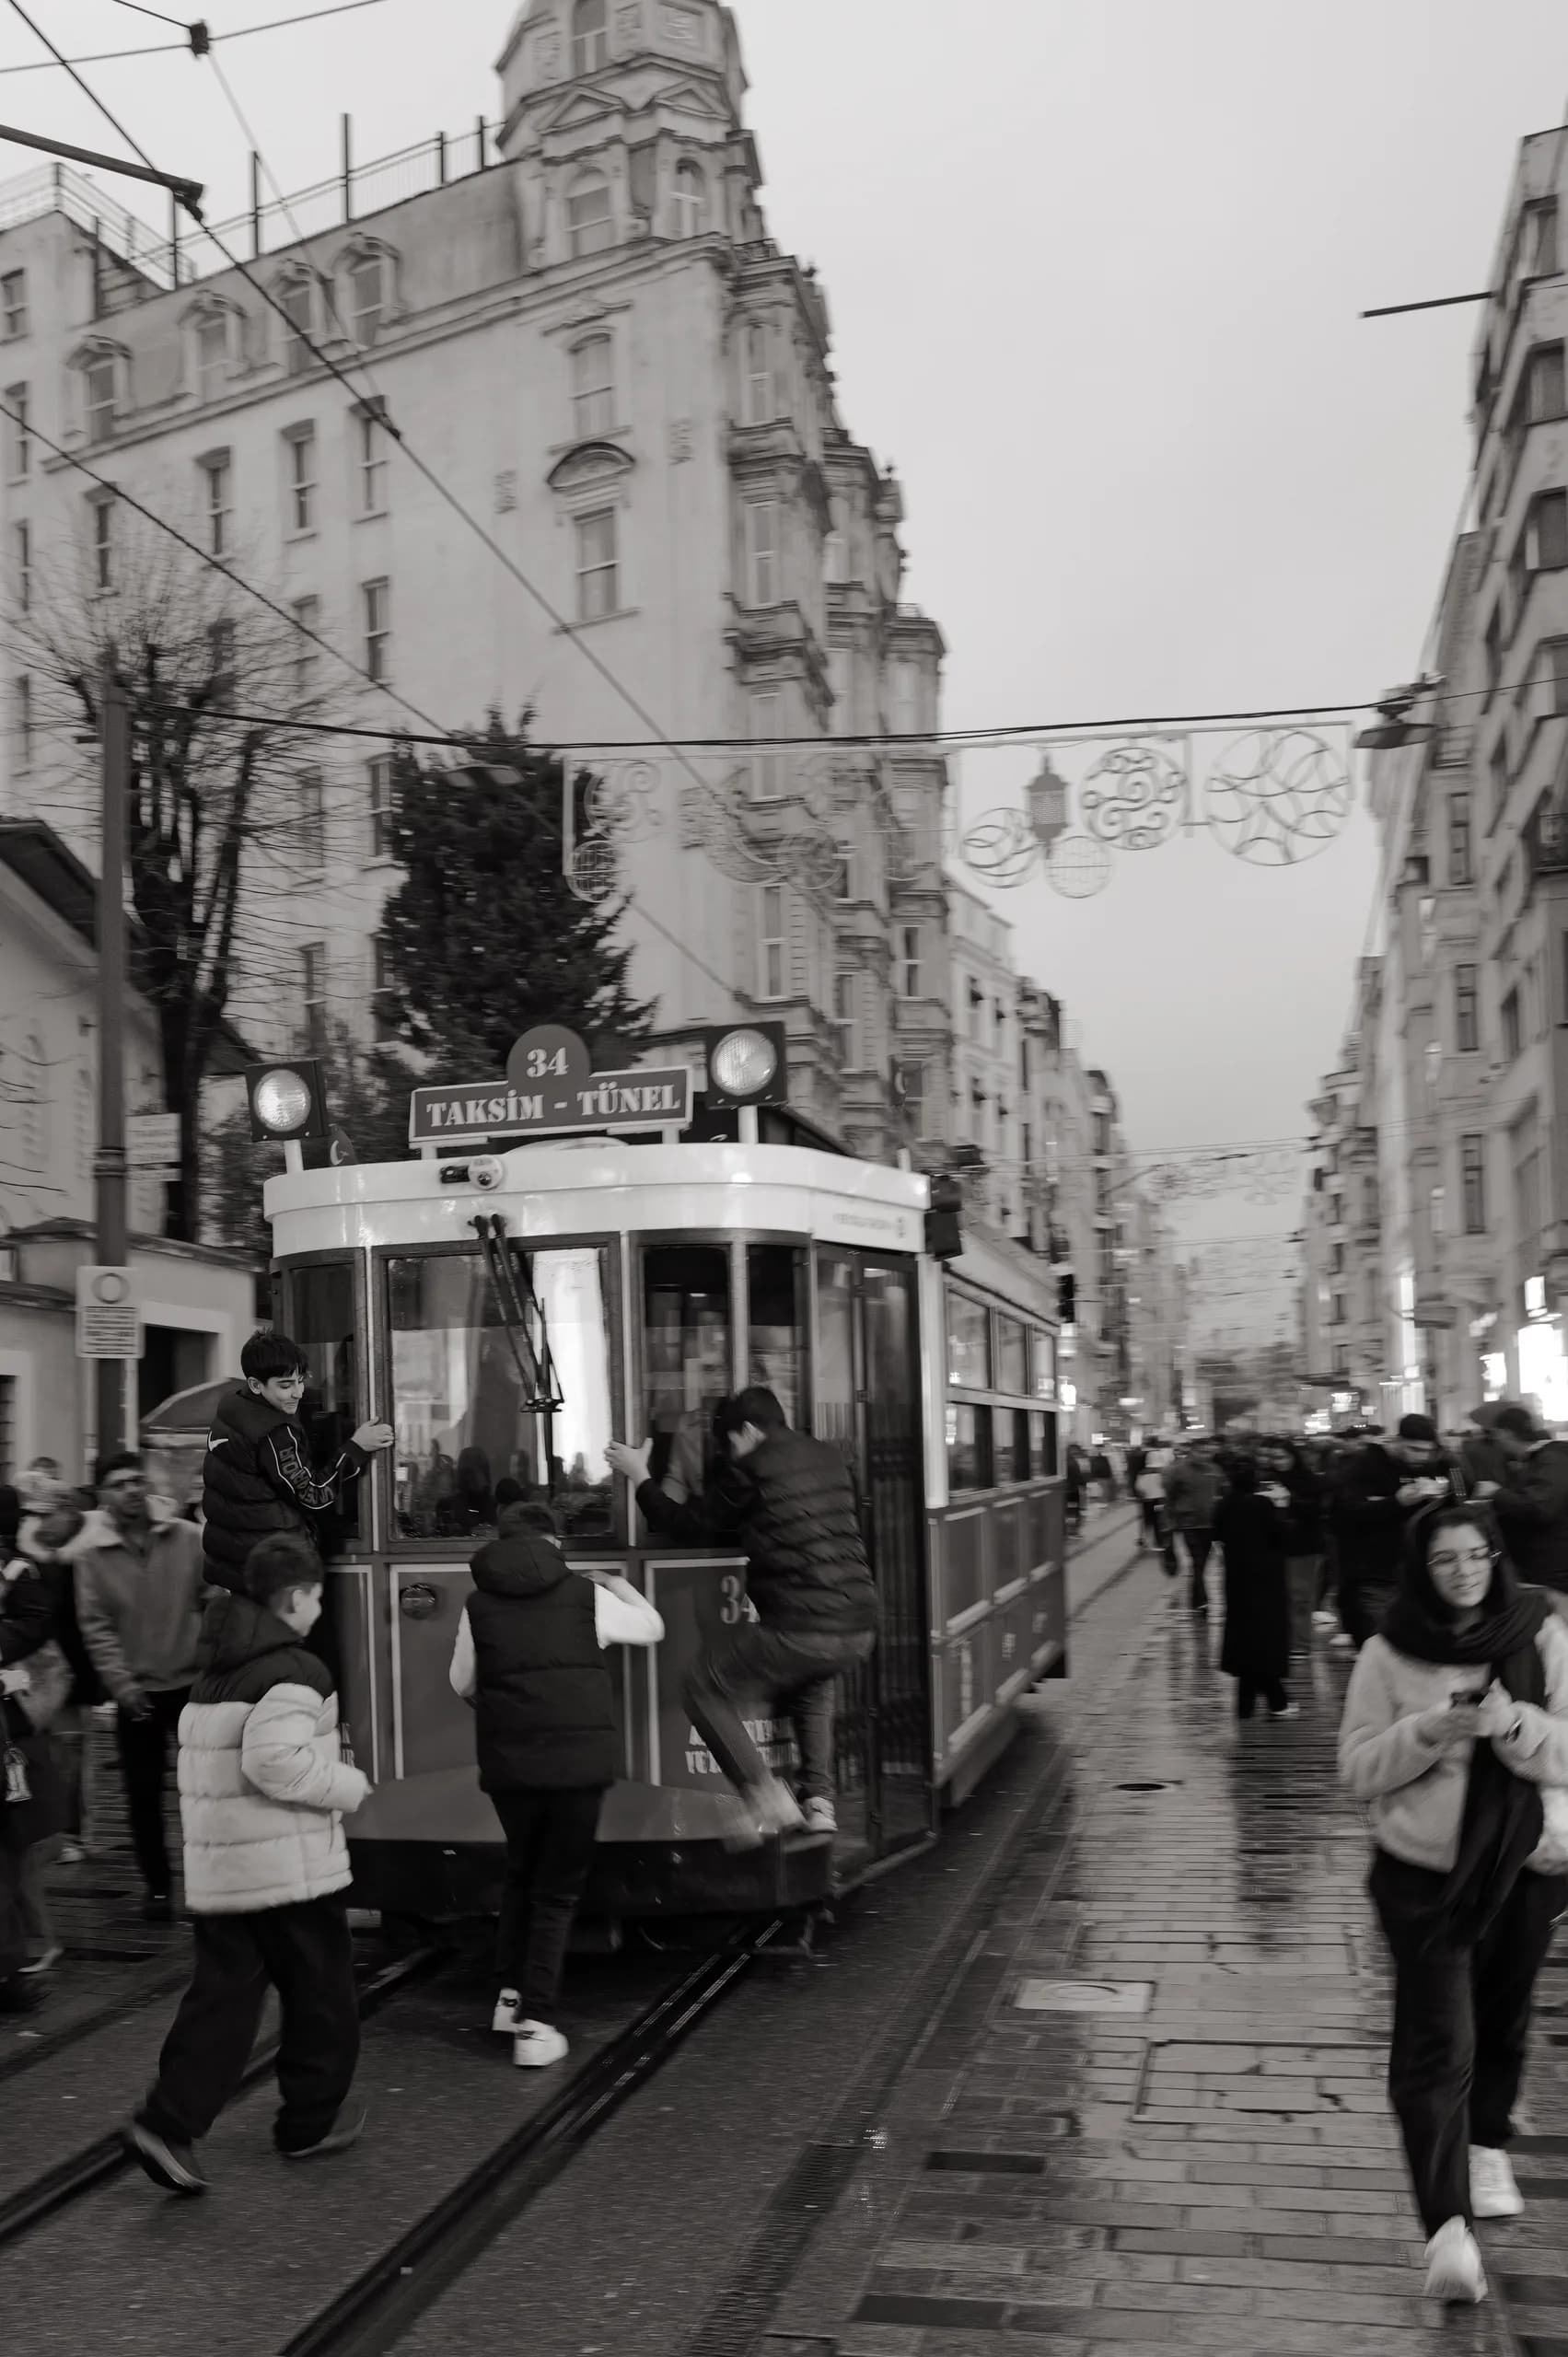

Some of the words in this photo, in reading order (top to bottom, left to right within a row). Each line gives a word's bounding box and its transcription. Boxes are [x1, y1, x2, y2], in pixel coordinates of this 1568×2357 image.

[526, 1047, 569, 1078] 34
[426, 1089, 545, 1128] TAKSİM
[576, 1082, 681, 1116] TÜNEL
